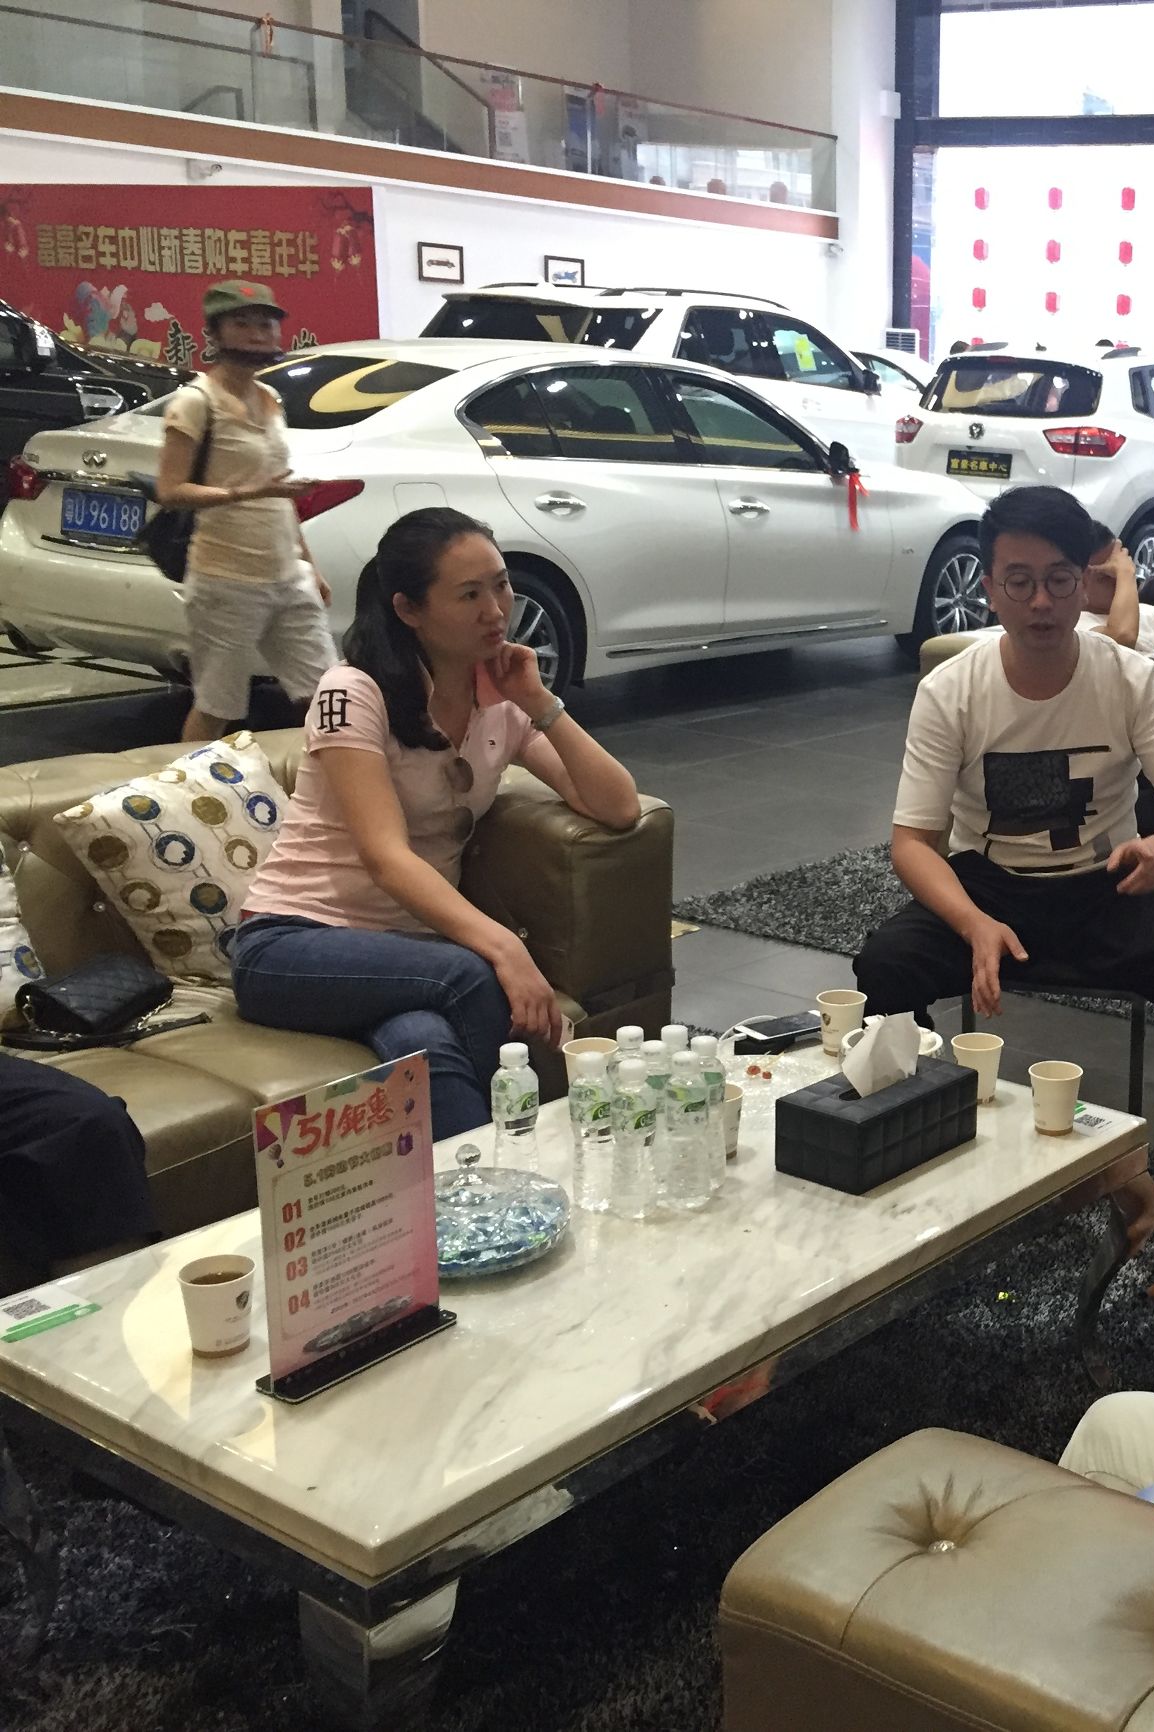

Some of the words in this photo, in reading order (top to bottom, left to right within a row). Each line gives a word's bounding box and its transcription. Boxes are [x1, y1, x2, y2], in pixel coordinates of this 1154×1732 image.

[281, 1198, 303, 1224] 01
[283, 1226, 306, 1253] 02
[286, 1256, 308, 1281] 03
[288, 1289, 311, 1315] 04
